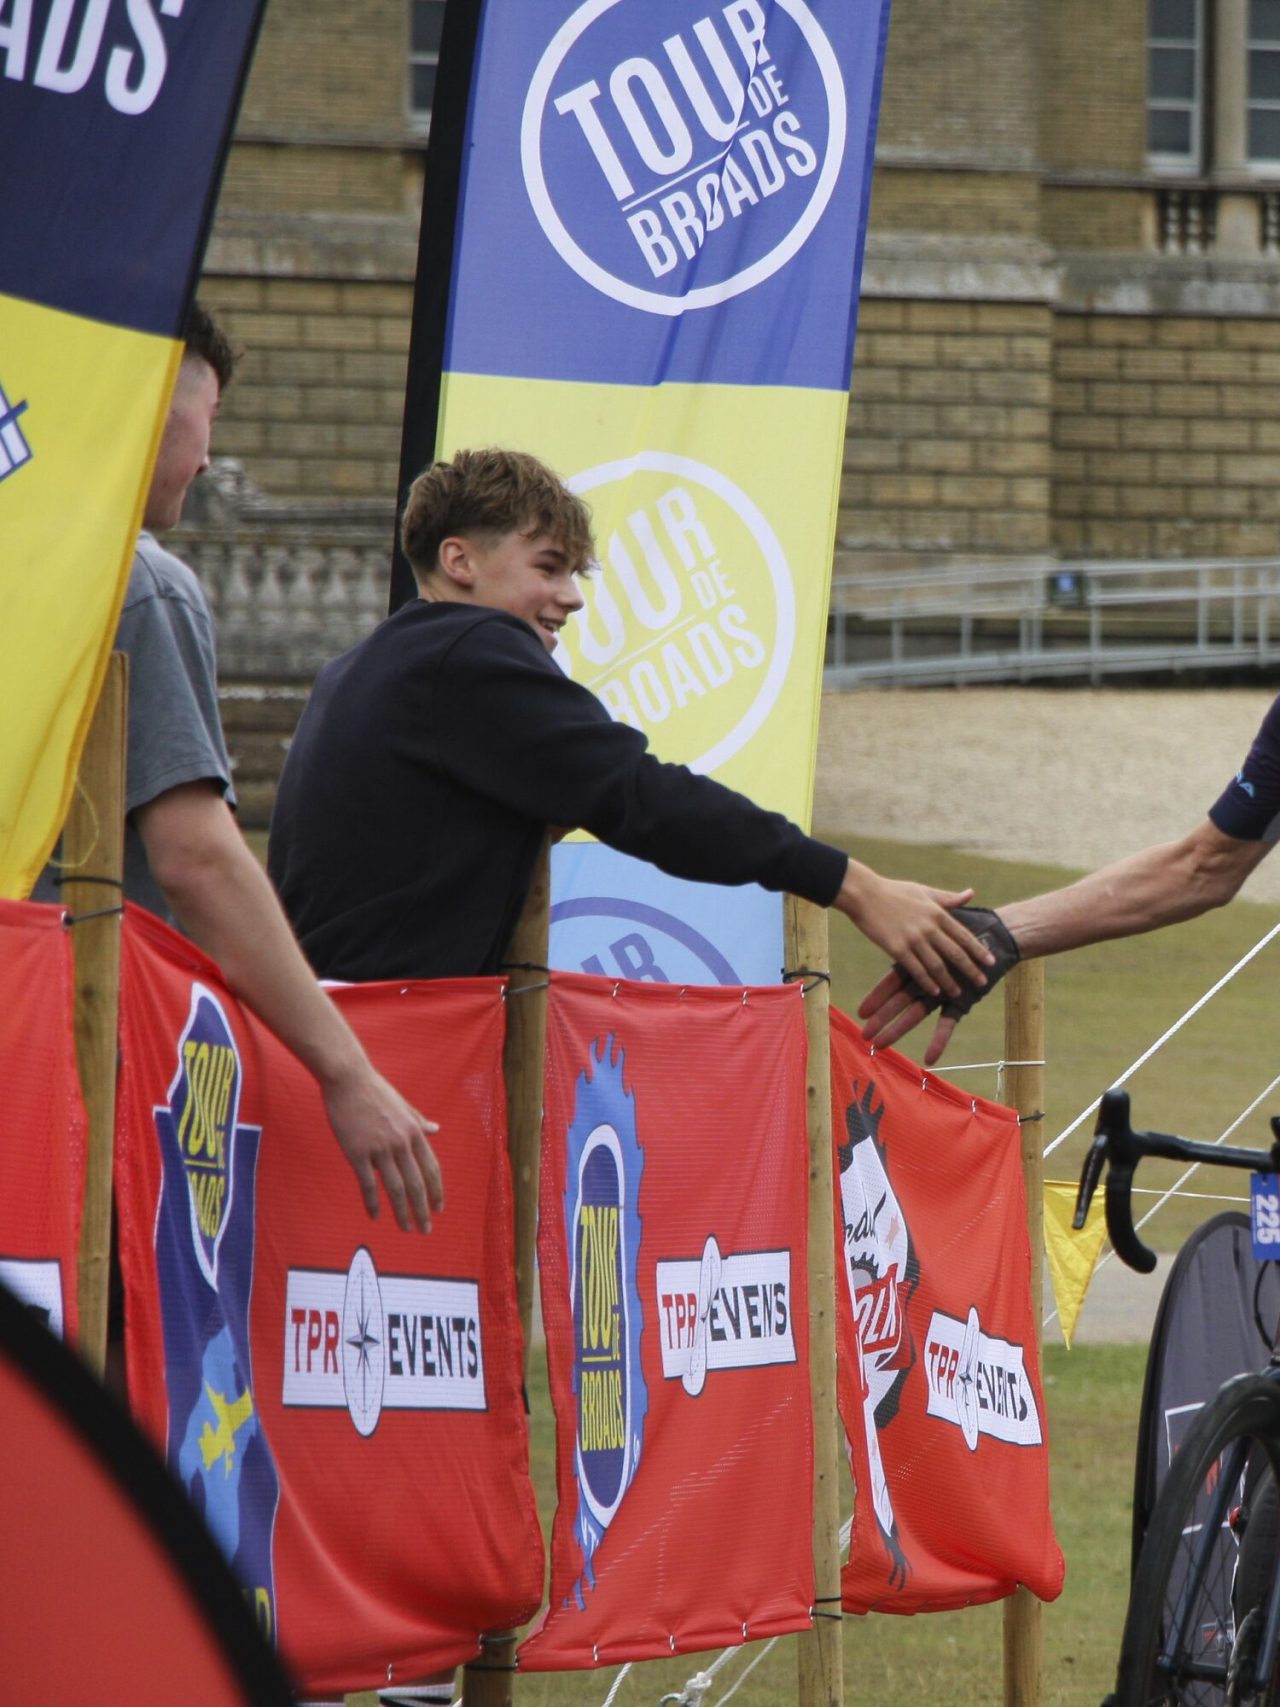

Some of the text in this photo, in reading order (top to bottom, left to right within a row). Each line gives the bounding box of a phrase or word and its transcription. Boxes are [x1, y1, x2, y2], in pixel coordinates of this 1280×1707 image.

[554, 0, 770, 201] TOUR
[748, 65, 789, 118] DE
[627, 111, 817, 278] BROADS
[555, 487, 716, 668] OUR
[691, 560, 736, 610] DE
[602, 603, 766, 732] ROADS
[178, 1040, 235, 1158] TOUR
[580, 1205, 619, 1351] TOUR
[661, 1292, 698, 1350] TPR
[708, 1281, 788, 1342] EVENS
[291, 1308, 479, 1380] TPR EVENTS
[928, 1340, 1029, 1422] TPR EVENTS
[580, 1368, 625, 1452] BROADS
